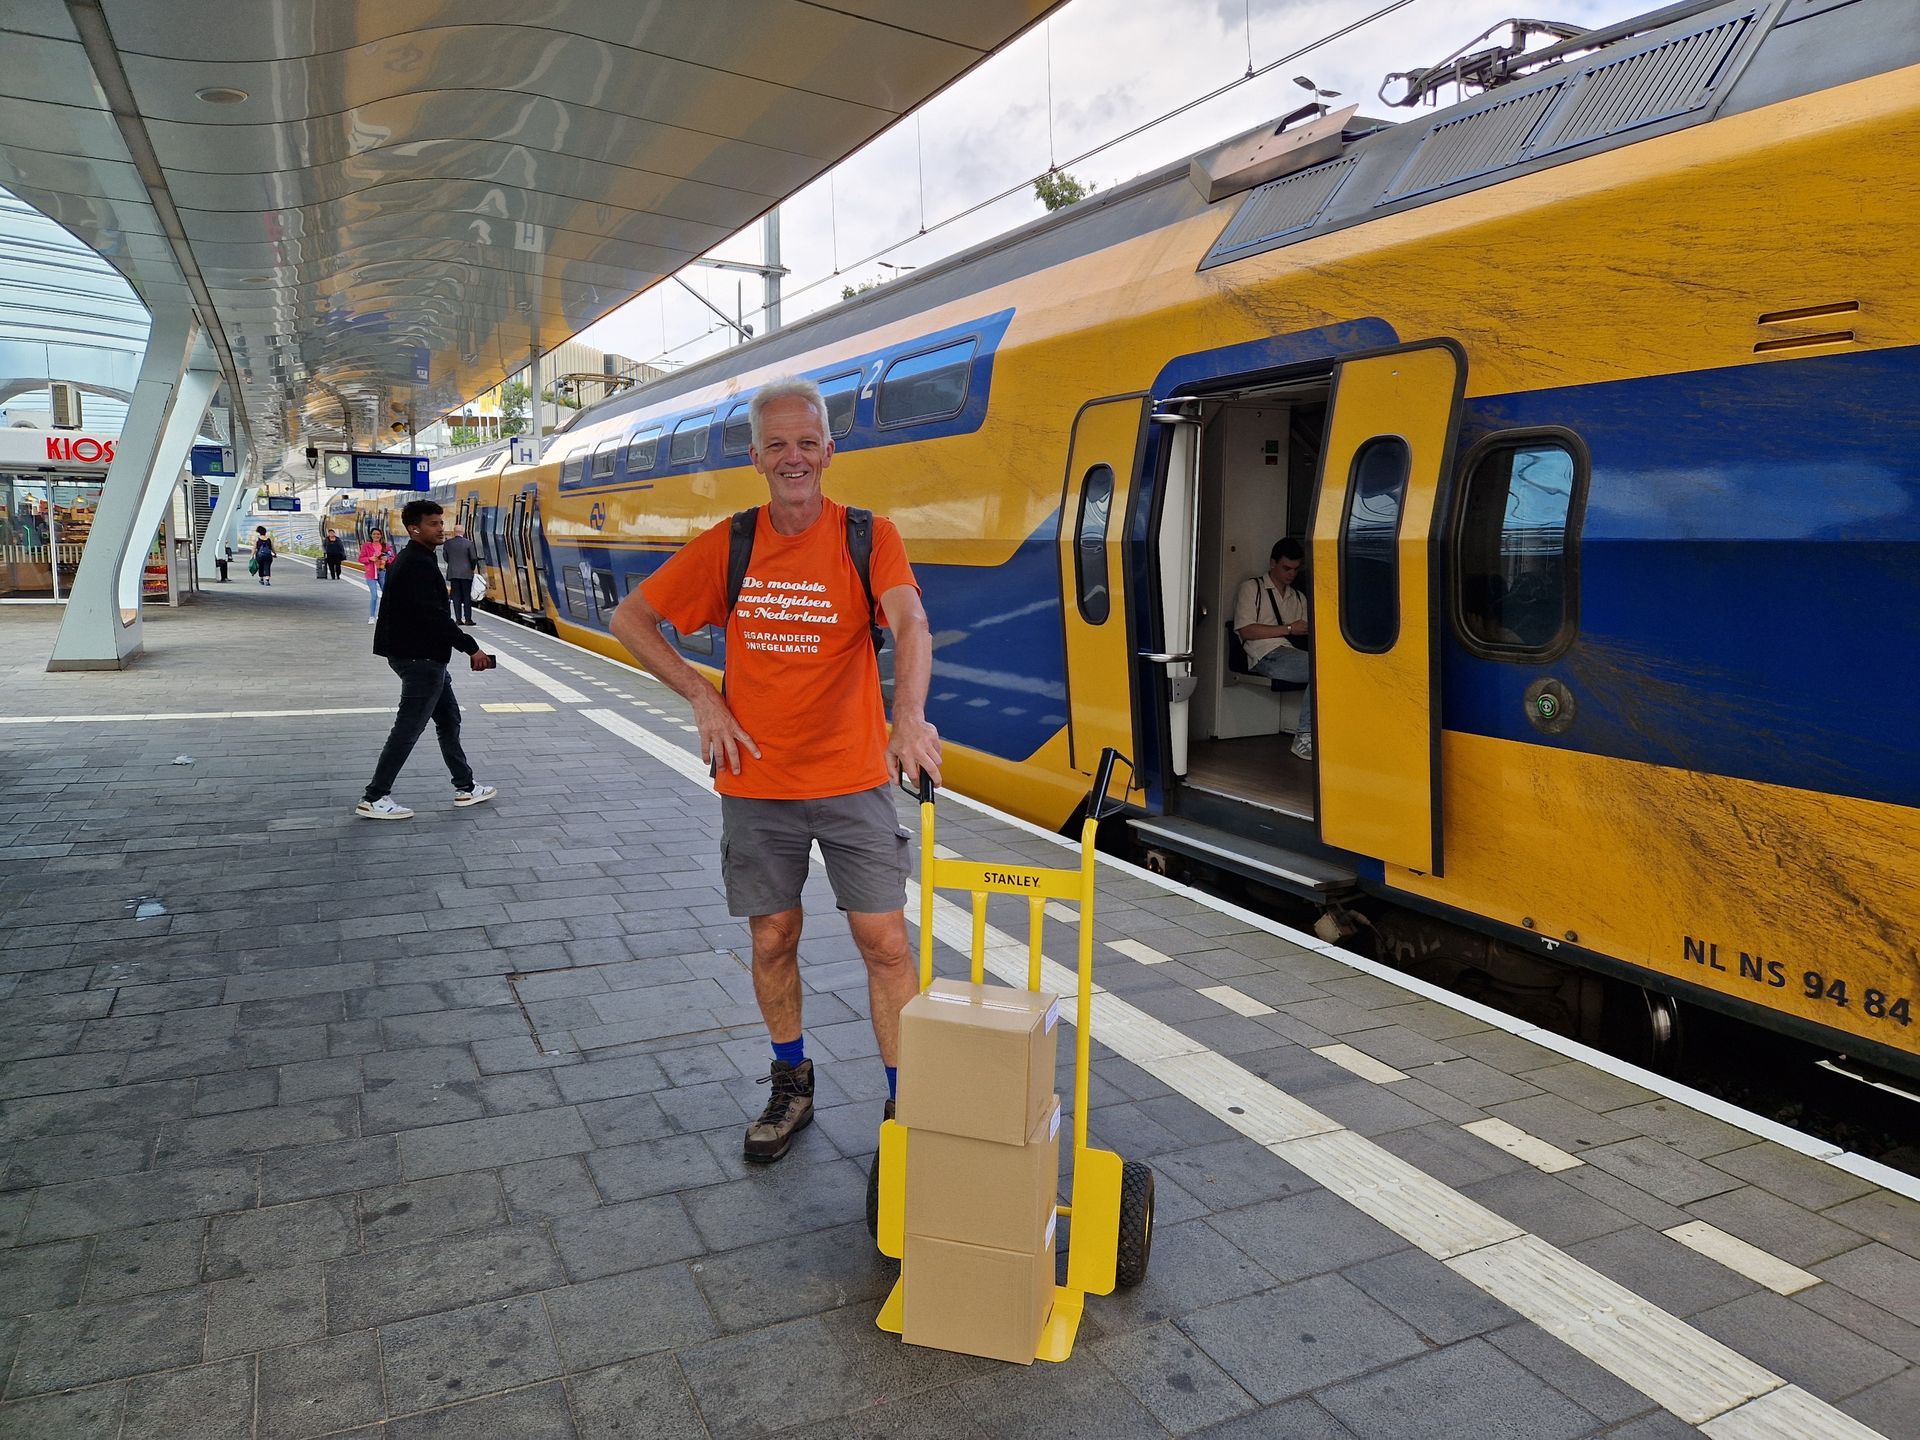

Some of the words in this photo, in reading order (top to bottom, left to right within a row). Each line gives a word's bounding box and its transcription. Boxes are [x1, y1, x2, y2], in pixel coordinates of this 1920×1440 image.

[861, 360, 884, 400] 2
[46, 437, 119, 463] KIOS
[520, 447, 533, 462] H
[742, 576, 764, 589] De
[767, 580, 827, 593] mooiste
[753, 606, 839, 624] Nederland
[984, 872, 1040, 887] STANLEY
[1683, 935, 1726, 972] NL
[1739, 951, 1786, 988] NS
[1802, 970, 1849, 1008] 94
[1863, 988, 1913, 1027] 84
